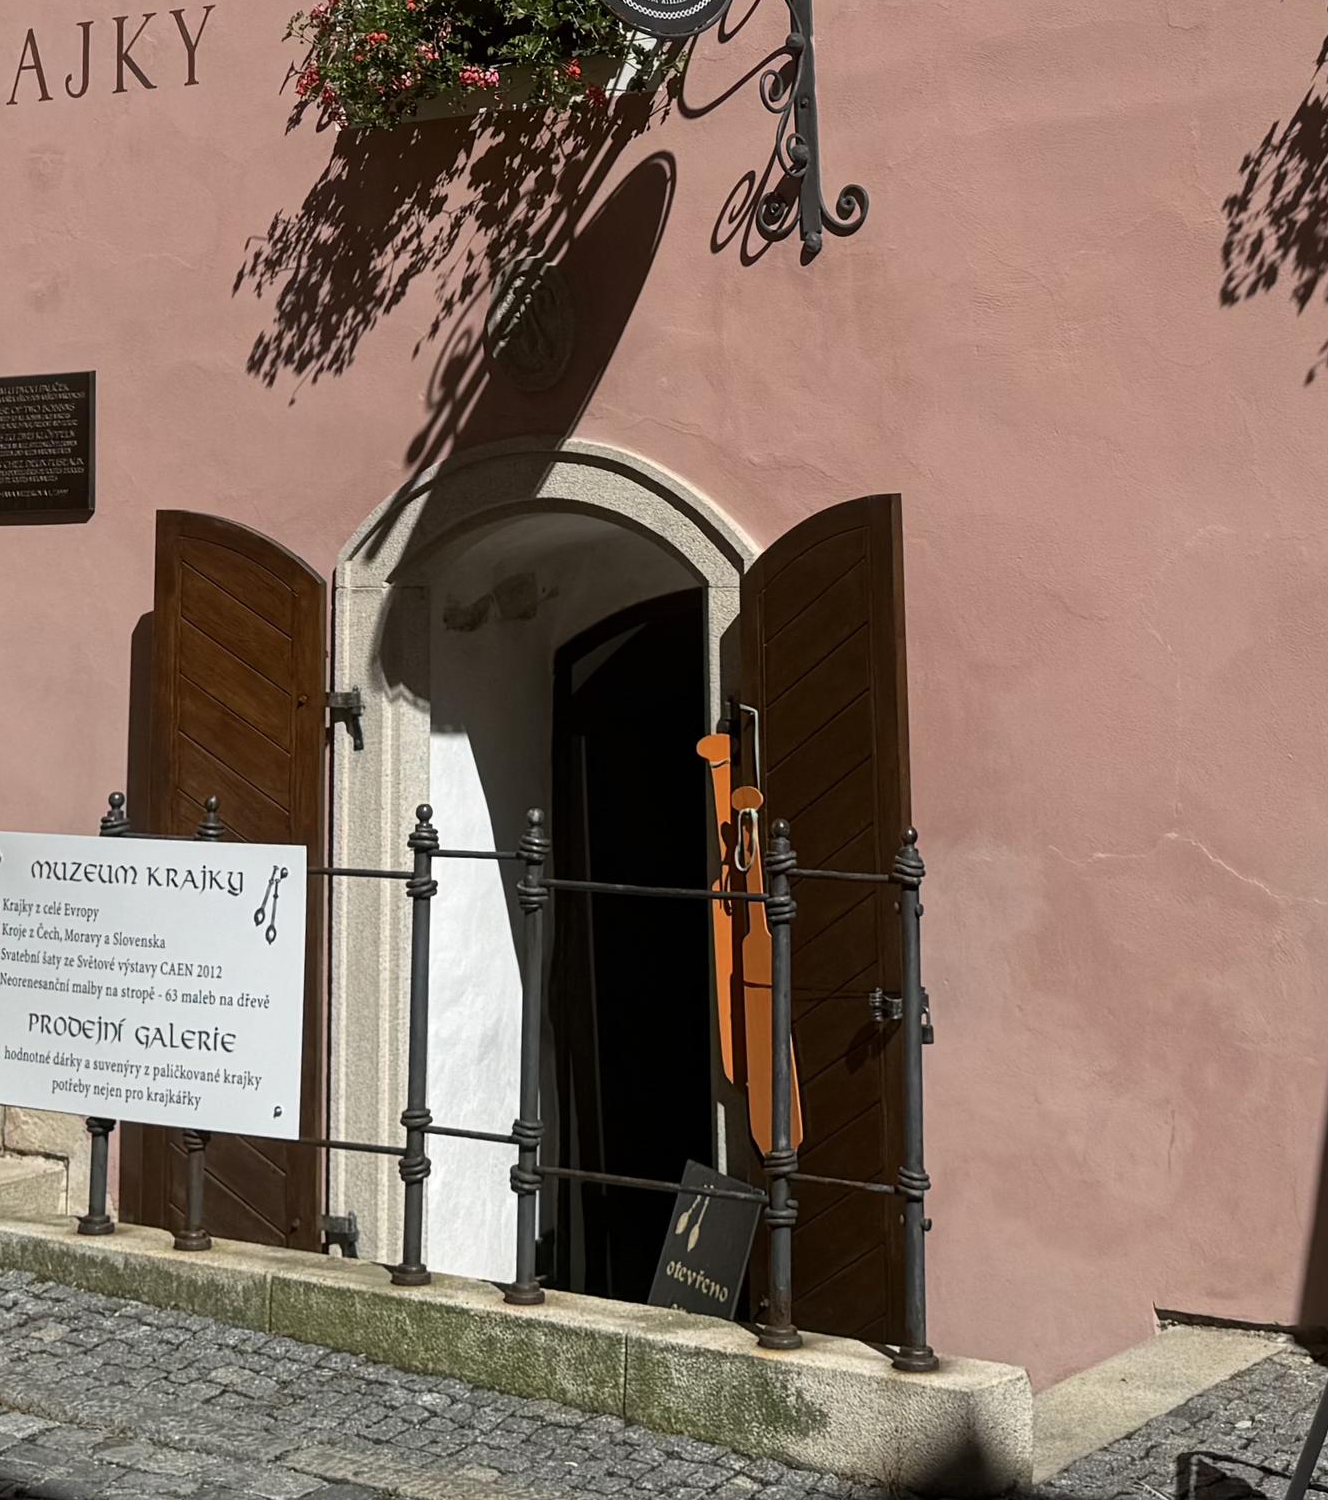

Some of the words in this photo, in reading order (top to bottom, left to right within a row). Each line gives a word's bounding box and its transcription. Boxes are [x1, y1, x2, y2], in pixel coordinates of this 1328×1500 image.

[31, 860, 138, 885] MUZEUM
[146, 865, 244, 896] KRAJKY
[3, 898, 33, 916] Krajky
[35, 904, 41, 914] z
[43, 901, 62, 916] celé
[64, 902, 99, 922] Evropy
[2, 923, 27, 940] Kroje
[29, 928, 34, 938] z
[37, 922, 63, 942] Čech,
[64, 928, 102, 948] Moravy
[104, 935, 110, 945] a
[113, 932, 166, 949] Slovenska
[0, 948, 40, 964] Svatební
[42, 950, 62, 970] šaty
[64, 957, 75, 968] ze
[77, 954, 115, 971] Světové
[118, 958, 158, 978] výstavy
[160, 962, 193, 977] CAEN
[197, 964, 223, 979] 2012
[0, 972, 69, 992] Neorenesanční
[72, 980, 103, 1000] malby
[105, 986, 118, 997] na
[121, 986, 155, 1004] stropě
[165, 988, 178, 1002] 63
[181, 990, 216, 1005] maleb
[219, 995, 233, 1006] na
[237, 993, 270, 1009] dřevě
[28, 1012, 126, 1044] PRODEJNÍ
[135, 1022, 236, 1053] GALERIE
[4, 1045, 51, 1064] hodnotné
[53, 1051, 82, 1072] dárky
[85, 1060, 91, 1069] a
[93, 1059, 141, 1079] suvenýry
[144, 1065, 150, 1076] z
[153, 1063, 221, 1083] paličkované
[223, 1068, 262, 1091] krajky
[52, 1078, 91, 1098] potřeby
[93, 1082, 122, 1100] nejen
[125, 1088, 144, 1103] pro
[146, 1086, 201, 1111] krajkářky
[666, 1260, 729, 1302] otevřeno
